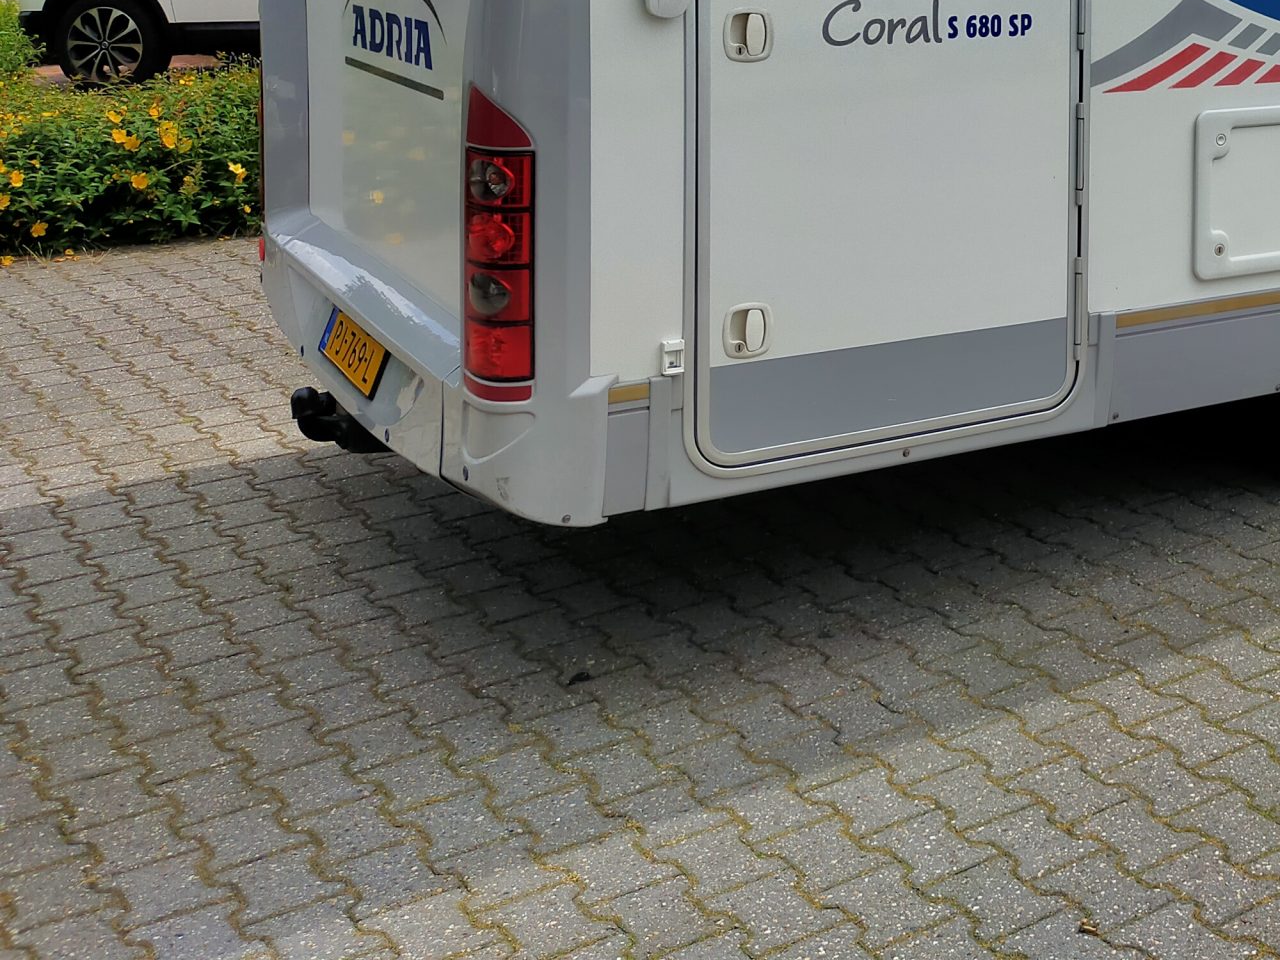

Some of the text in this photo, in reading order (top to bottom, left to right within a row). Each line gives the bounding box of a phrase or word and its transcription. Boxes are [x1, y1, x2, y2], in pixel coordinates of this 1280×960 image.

[352, 3, 433, 71] ADRIA
[947, 15, 959, 39] S
[966, 14, 1002, 38] 680
[1008, 13, 1033, 37] SP
[329, 319, 375, 385] PJ-769-L
